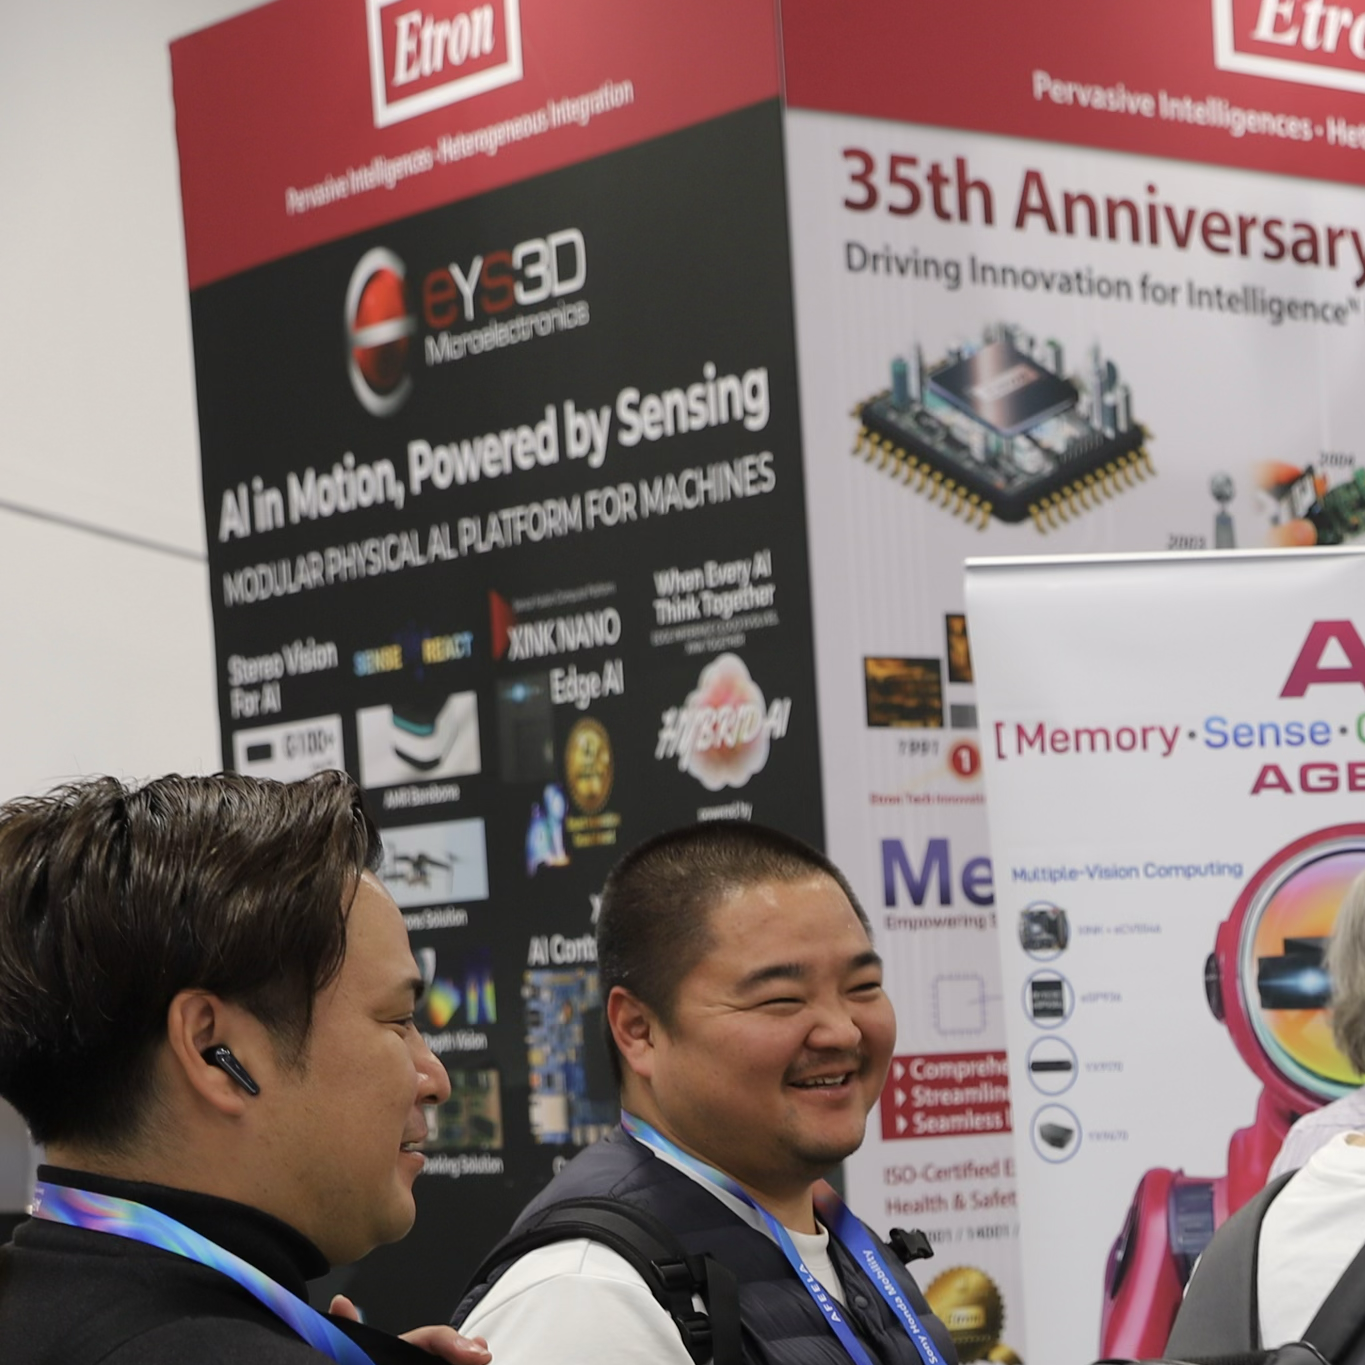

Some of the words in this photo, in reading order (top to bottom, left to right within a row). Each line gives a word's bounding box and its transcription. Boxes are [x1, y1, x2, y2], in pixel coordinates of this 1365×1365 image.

[392, 3, 495, 87] Etron
[1033, 70, 1155, 118] Pervasive
[1158, 91, 1313, 141] Intelligences
[286, 174, 348, 216] Pervasive
[348, 147, 433, 195] Intelligences
[549, 79, 634, 127] Integration
[843, 147, 993, 226] 35th
[846, 242, 960, 291] Driving
[970, 256, 1134, 302] Innovation
[1140, 275, 1178, 306] for
[425, 299, 590, 366] Microelectronics
[219, 484, 251, 543] AI
[252, 476, 285, 532] in
[288, 452, 406, 526] Motion,
[408, 405, 560, 496] Powered
[564, 400, 611, 469] by
[616, 361, 769, 448] Sensing
[223, 551, 325, 608] MODULAR
[324, 531, 427, 584] PHYSICAL
[458, 493, 583, 558] PLATFORM
[586, 482, 637, 529] FOR
[640, 451, 776, 517] MACHINES
[654, 565, 703, 596] When
[704, 558, 751, 588] Every
[752, 548, 773, 579] AI
[653, 597, 700, 625] Think
[700, 583, 775, 620] Together
[508, 618, 557, 661] XINK
[556, 607, 621, 655] NANO
[227, 652, 284, 686] Stereo
[282, 636, 338, 676] Vision
[551, 664, 601, 711] Edge
[601, 658, 624, 698] AI
[230, 687, 261, 719] For
[260, 681, 281, 714] AI
[765, 697, 792, 740] AI
[1203, 716, 1331, 749] Sense
[1012, 864, 1141, 884] Multiple-Vision
[1143, 860, 1244, 880] Computing
[885, 914, 988, 931] Empowering
[528, 936, 549, 967] AI
[912, 1109, 1004, 1134] Seamless
[884, 1159, 998, 1185] ISO-Certified
[886, 1195, 948, 1217] Health
[953, 1193, 966, 1211] &
[799, 1263, 841, 1324] AFEELA
[863, 1248, 897, 1297] Mobility
[894, 1295, 919, 1334] Honda
[918, 1333, 938, 1364] Sony
